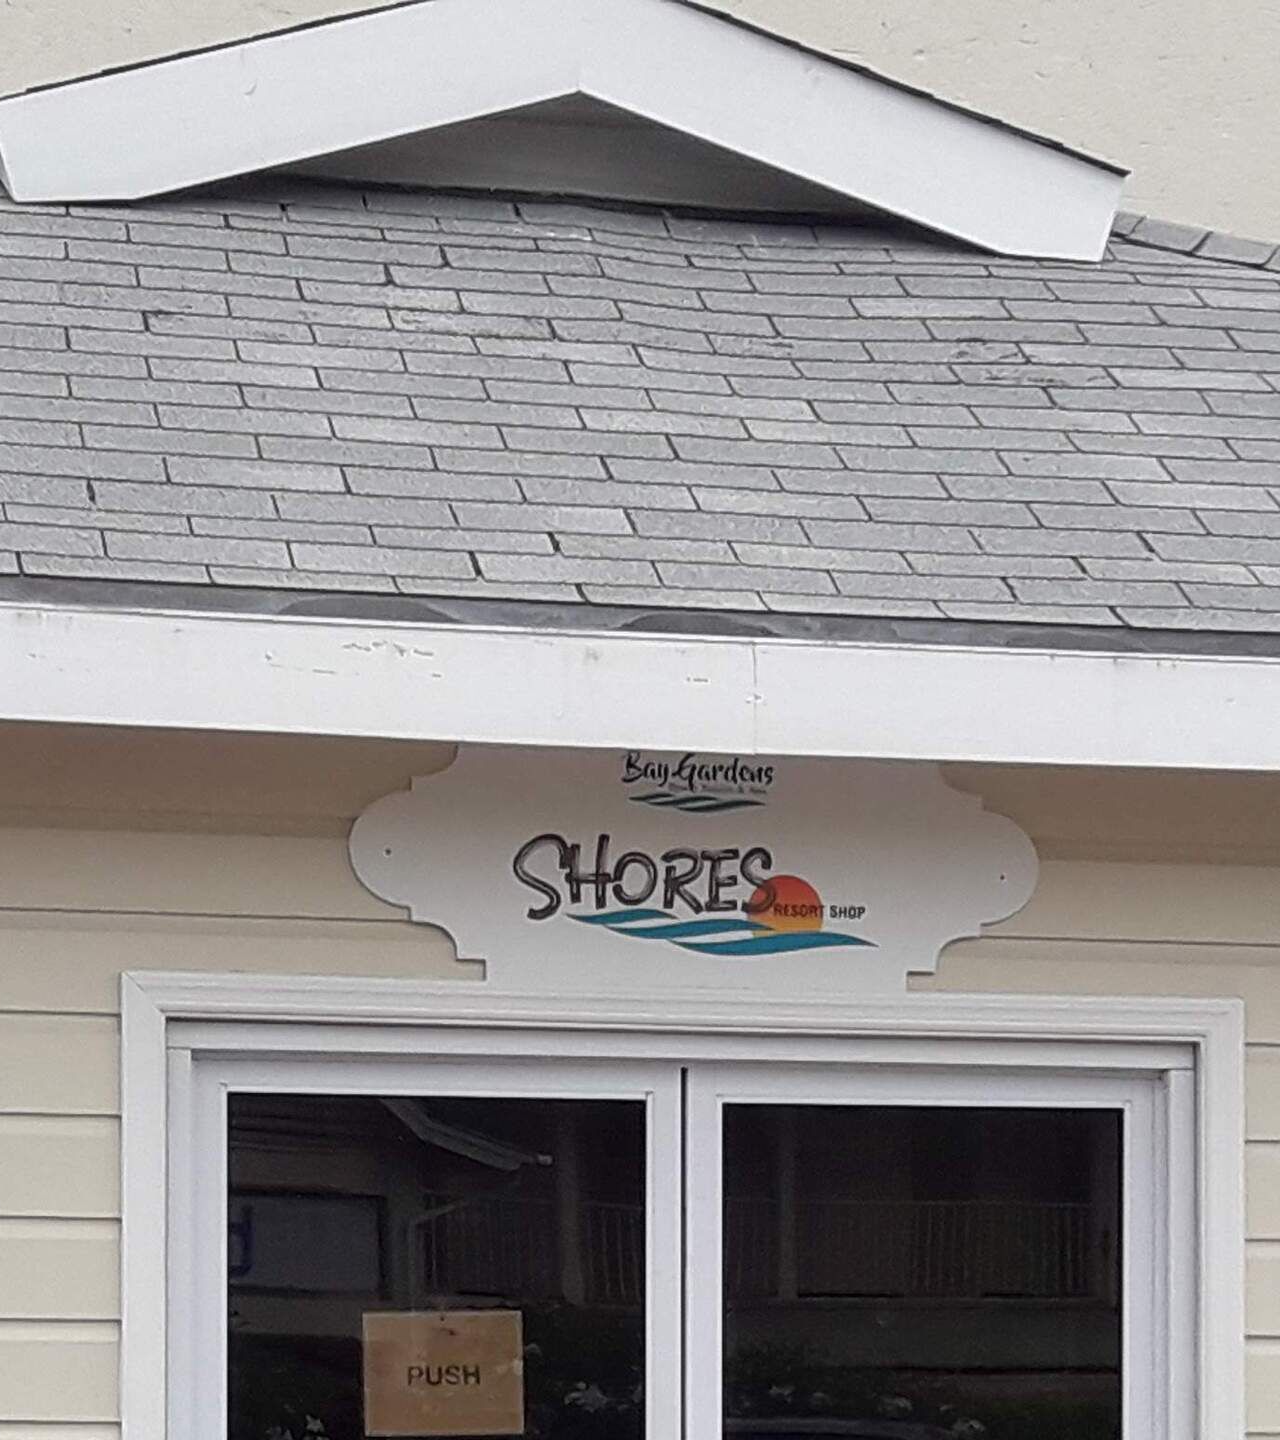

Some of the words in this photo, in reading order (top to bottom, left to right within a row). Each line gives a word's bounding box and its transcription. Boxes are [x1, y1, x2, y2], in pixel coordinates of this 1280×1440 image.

[621, 751, 669, 787] Bay
[672, 753, 774, 792] Gardens
[513, 833, 776, 920] SHORES
[773, 903, 824, 919] RESORT
[829, 905, 866, 920] SHOP
[407, 1366, 481, 1386] PUSH
